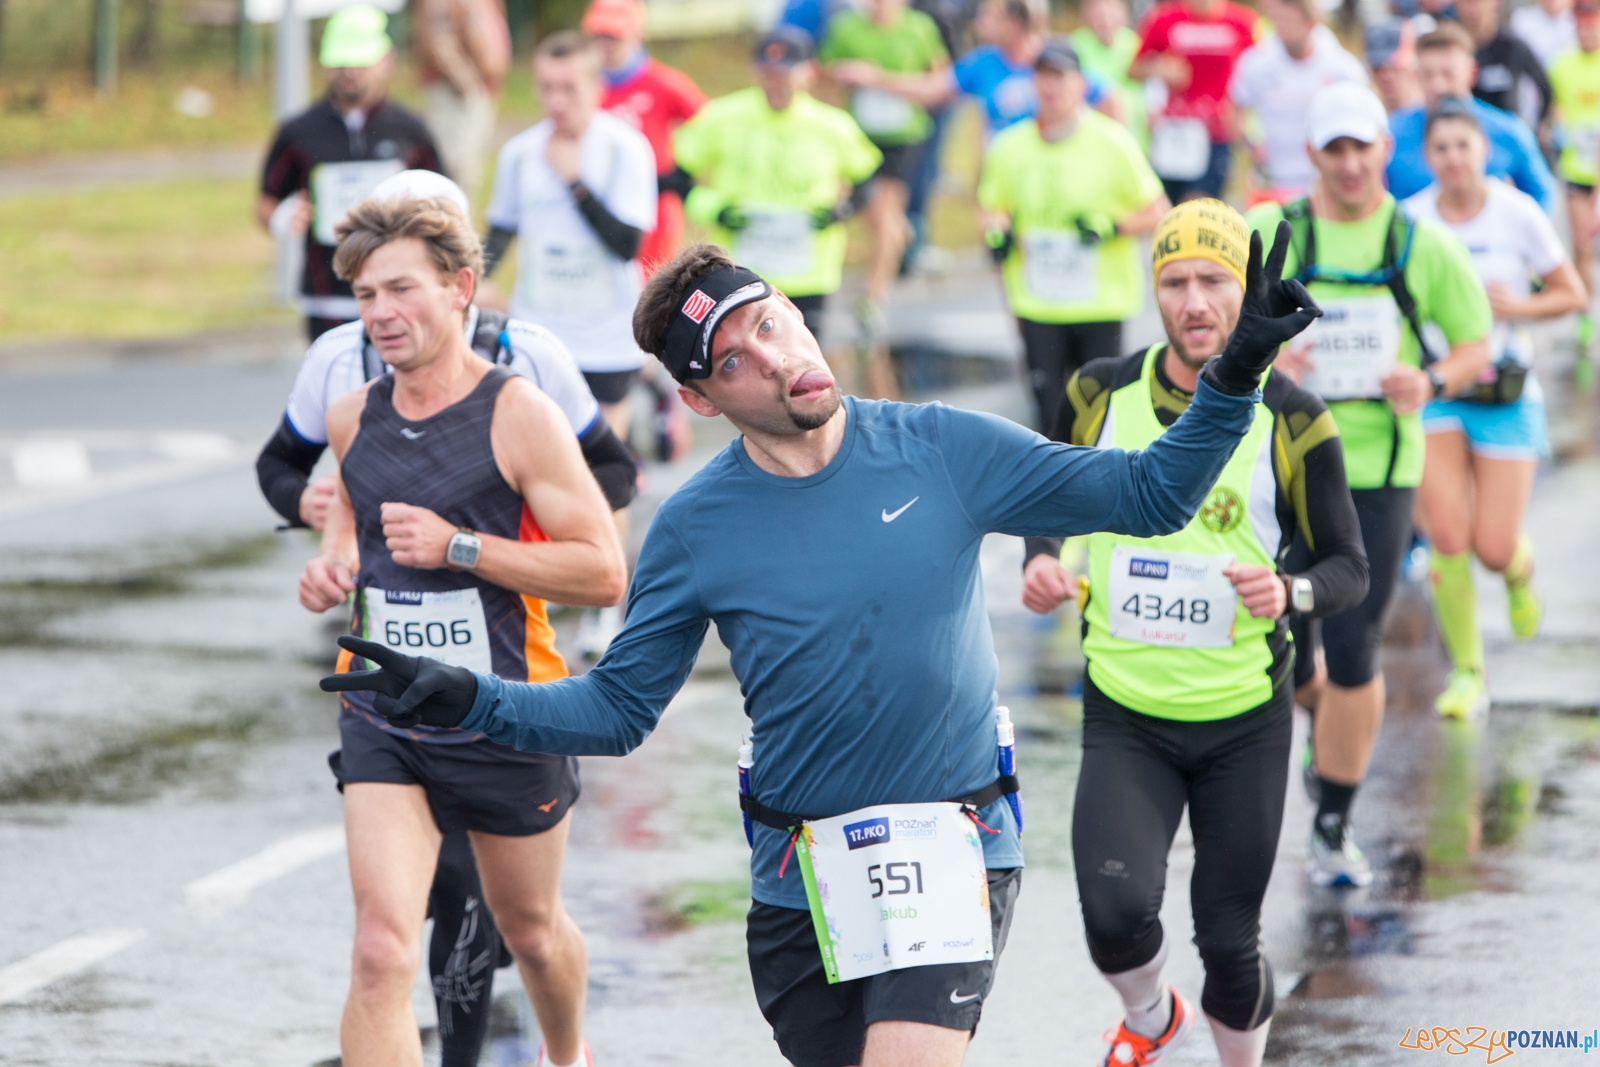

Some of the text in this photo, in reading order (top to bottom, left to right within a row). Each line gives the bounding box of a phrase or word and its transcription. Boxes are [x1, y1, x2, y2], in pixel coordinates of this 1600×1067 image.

[1122, 593, 1210, 624] 4348
[386, 619, 471, 647] 6606
[849, 824, 886, 842] 17.PKO
[895, 828, 937, 837] maraton
[868, 861, 924, 899] 551
[880, 906, 918, 922] Jakub
